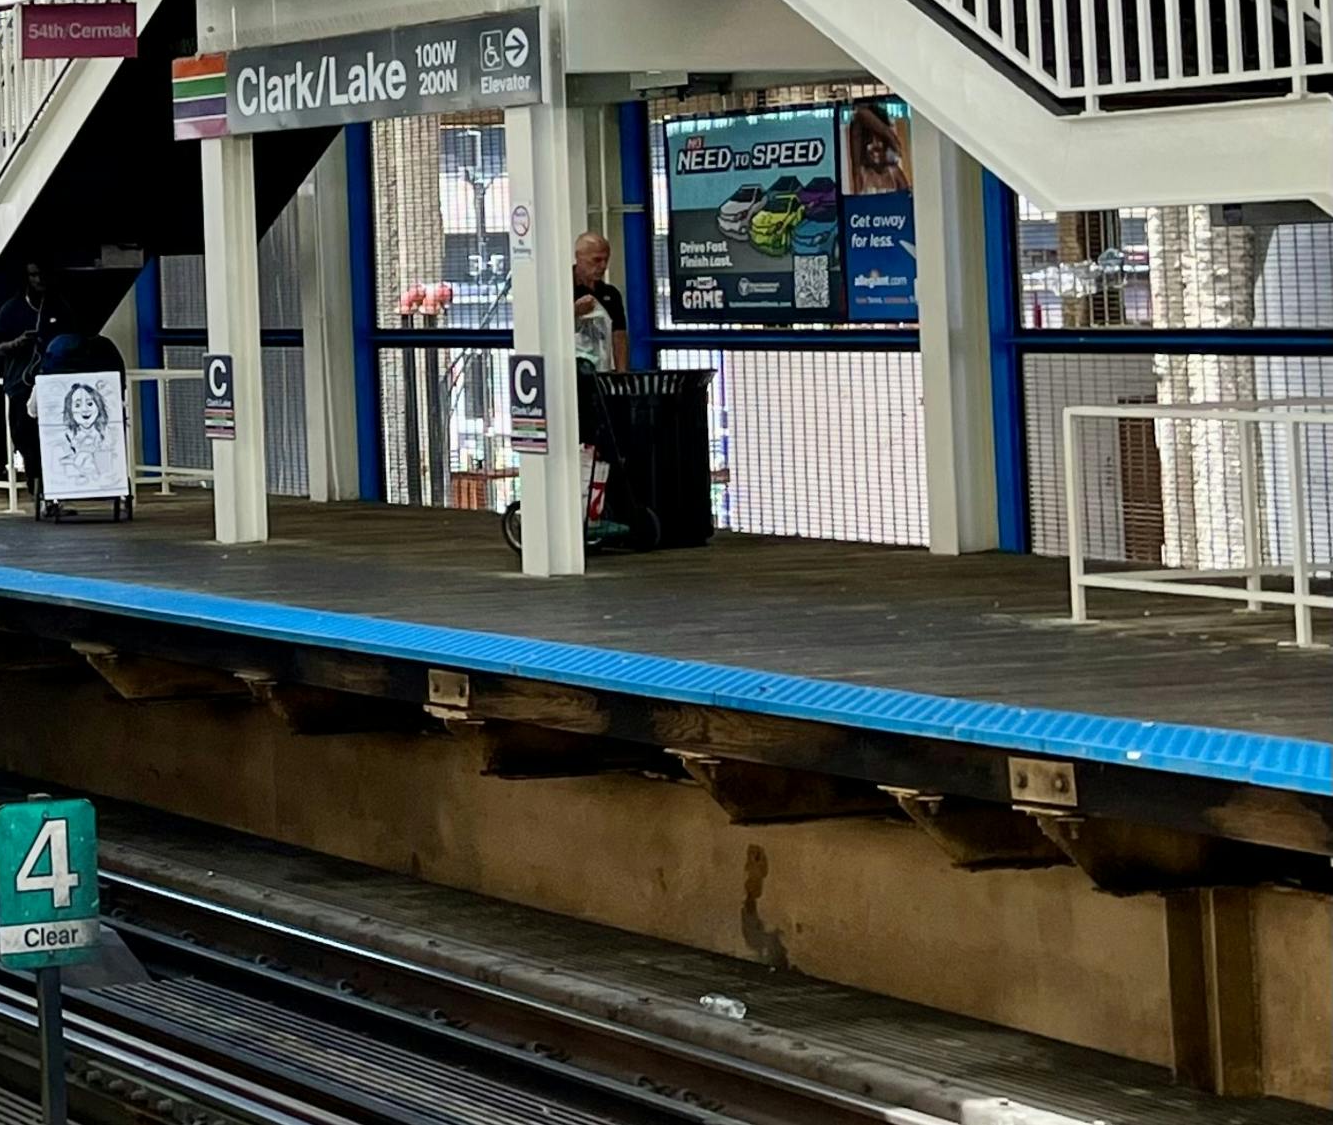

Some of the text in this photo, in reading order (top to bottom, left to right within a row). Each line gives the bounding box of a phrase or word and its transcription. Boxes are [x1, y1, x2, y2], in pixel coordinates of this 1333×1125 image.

[415, 40, 457, 68] 100W
[236, 51, 407, 117] Clark/Lake
[418, 69, 458, 96] 200N
[480, 73, 532, 95] Elevator
[677, 147, 731, 171] NEED
[752, 140, 824, 166] SPEED
[850, 214, 907, 231] Get away
[680, 241, 705, 254] Drive
[851, 232, 895, 250] for less.
[681, 256, 709, 267] Finish
[682, 290, 724, 309] GAME
[208, 358, 228, 398] C
[514, 359, 538, 405] C
[16, 819, 79, 908] 4
[24, 927, 79, 949] Clear
